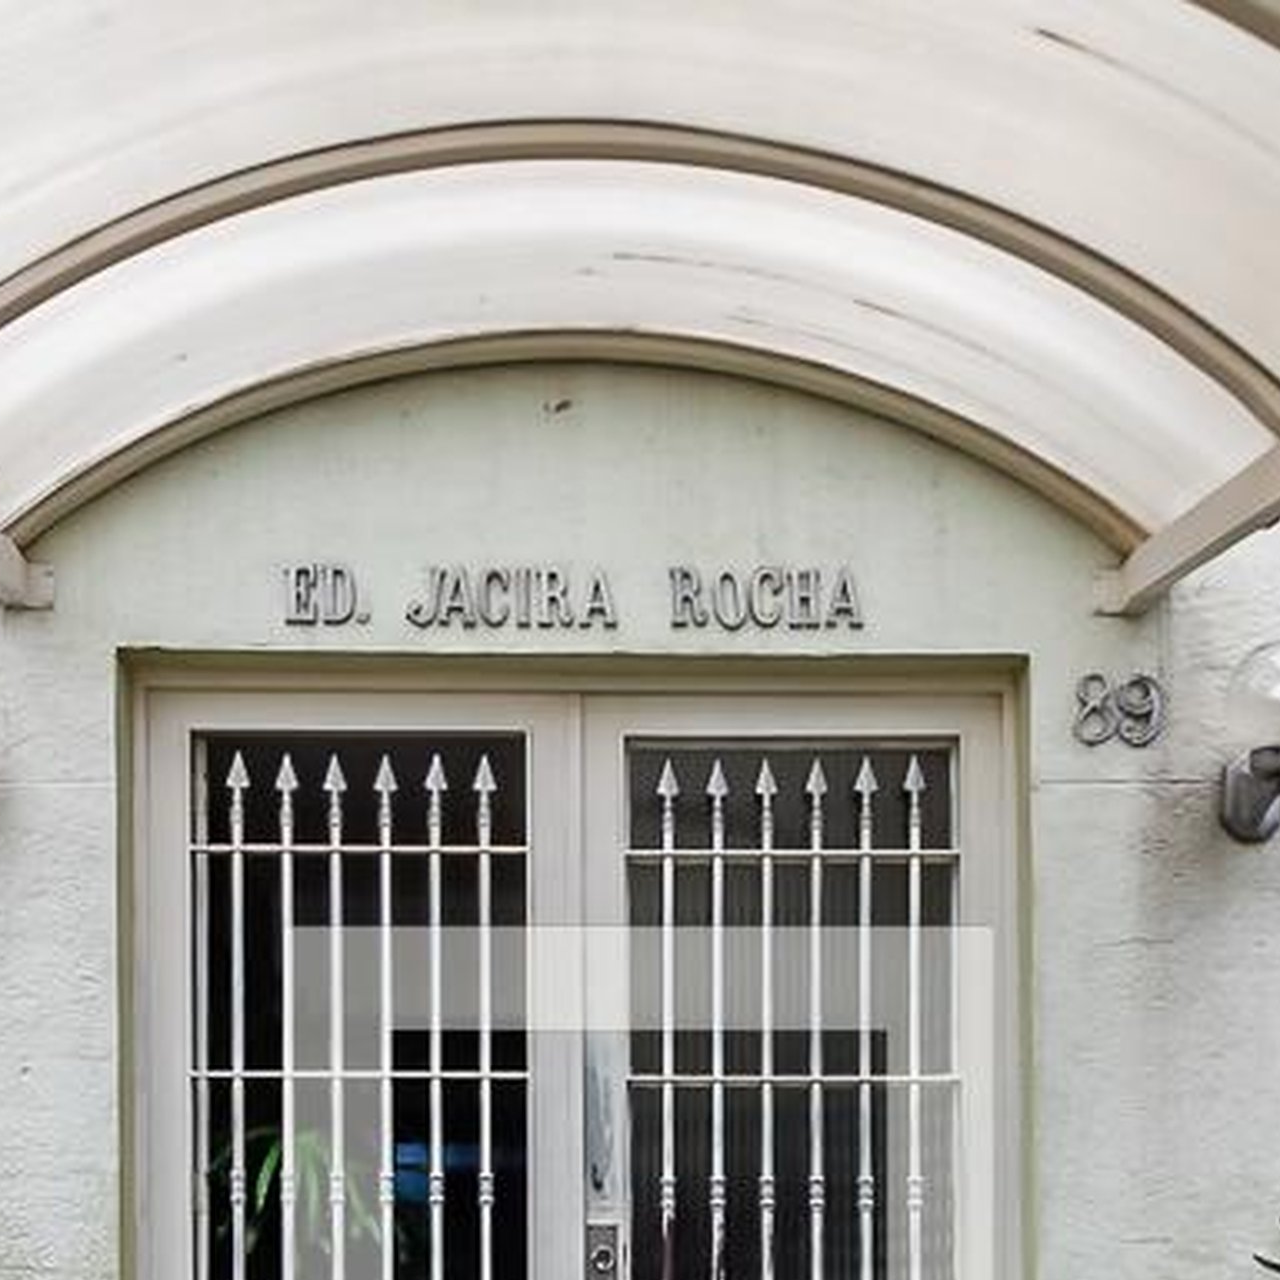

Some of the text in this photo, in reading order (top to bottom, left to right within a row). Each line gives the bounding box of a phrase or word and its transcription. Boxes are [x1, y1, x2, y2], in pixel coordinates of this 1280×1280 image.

[283, 566, 865, 631] ED. JACIRA ROCHA
[1072, 673, 1166, 748] 89
